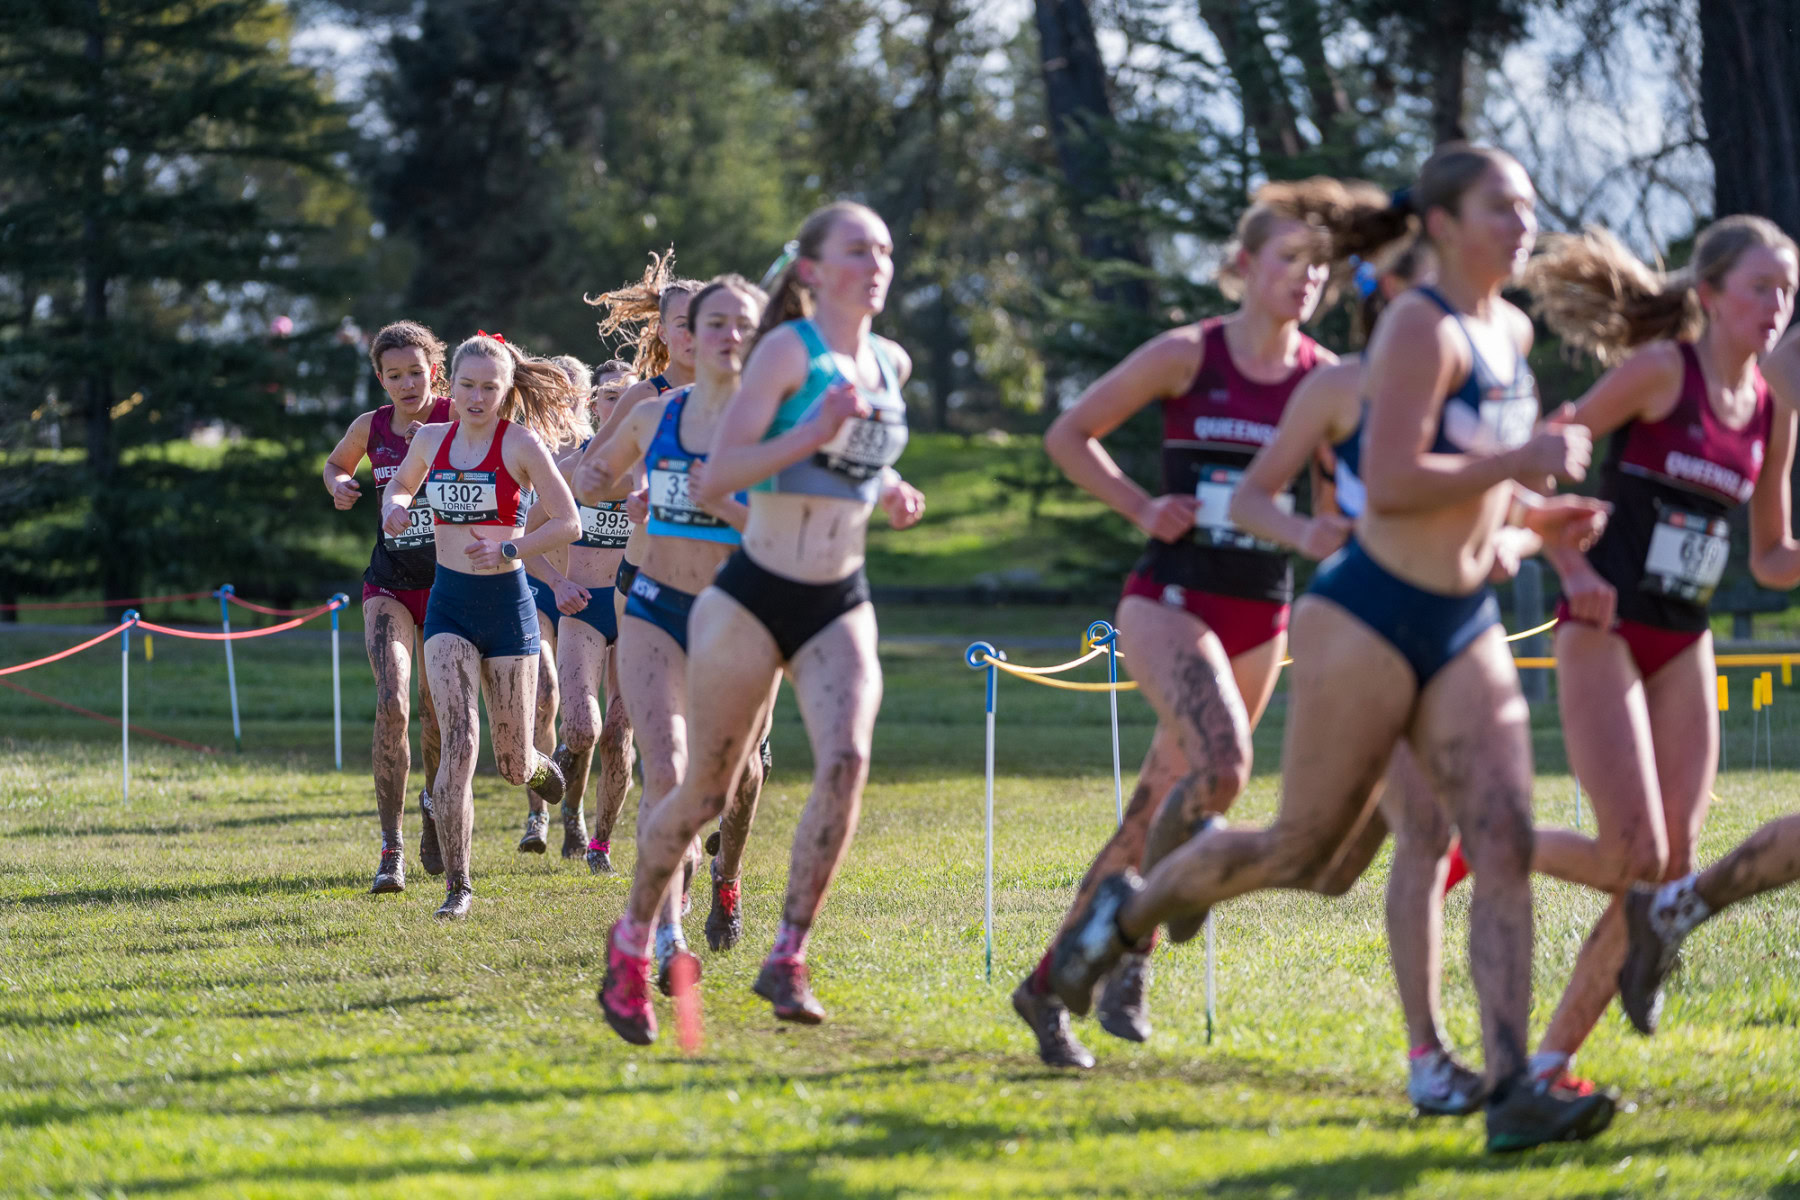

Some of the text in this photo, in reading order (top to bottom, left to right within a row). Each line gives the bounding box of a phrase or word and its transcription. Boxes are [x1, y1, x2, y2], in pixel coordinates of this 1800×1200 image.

[373, 465, 401, 482] QUEE
[437, 484, 483, 503] 1302
[443, 502, 478, 511] TORNEY
[596, 512, 629, 529] 995
[588, 526, 633, 536] CALLAHAN
